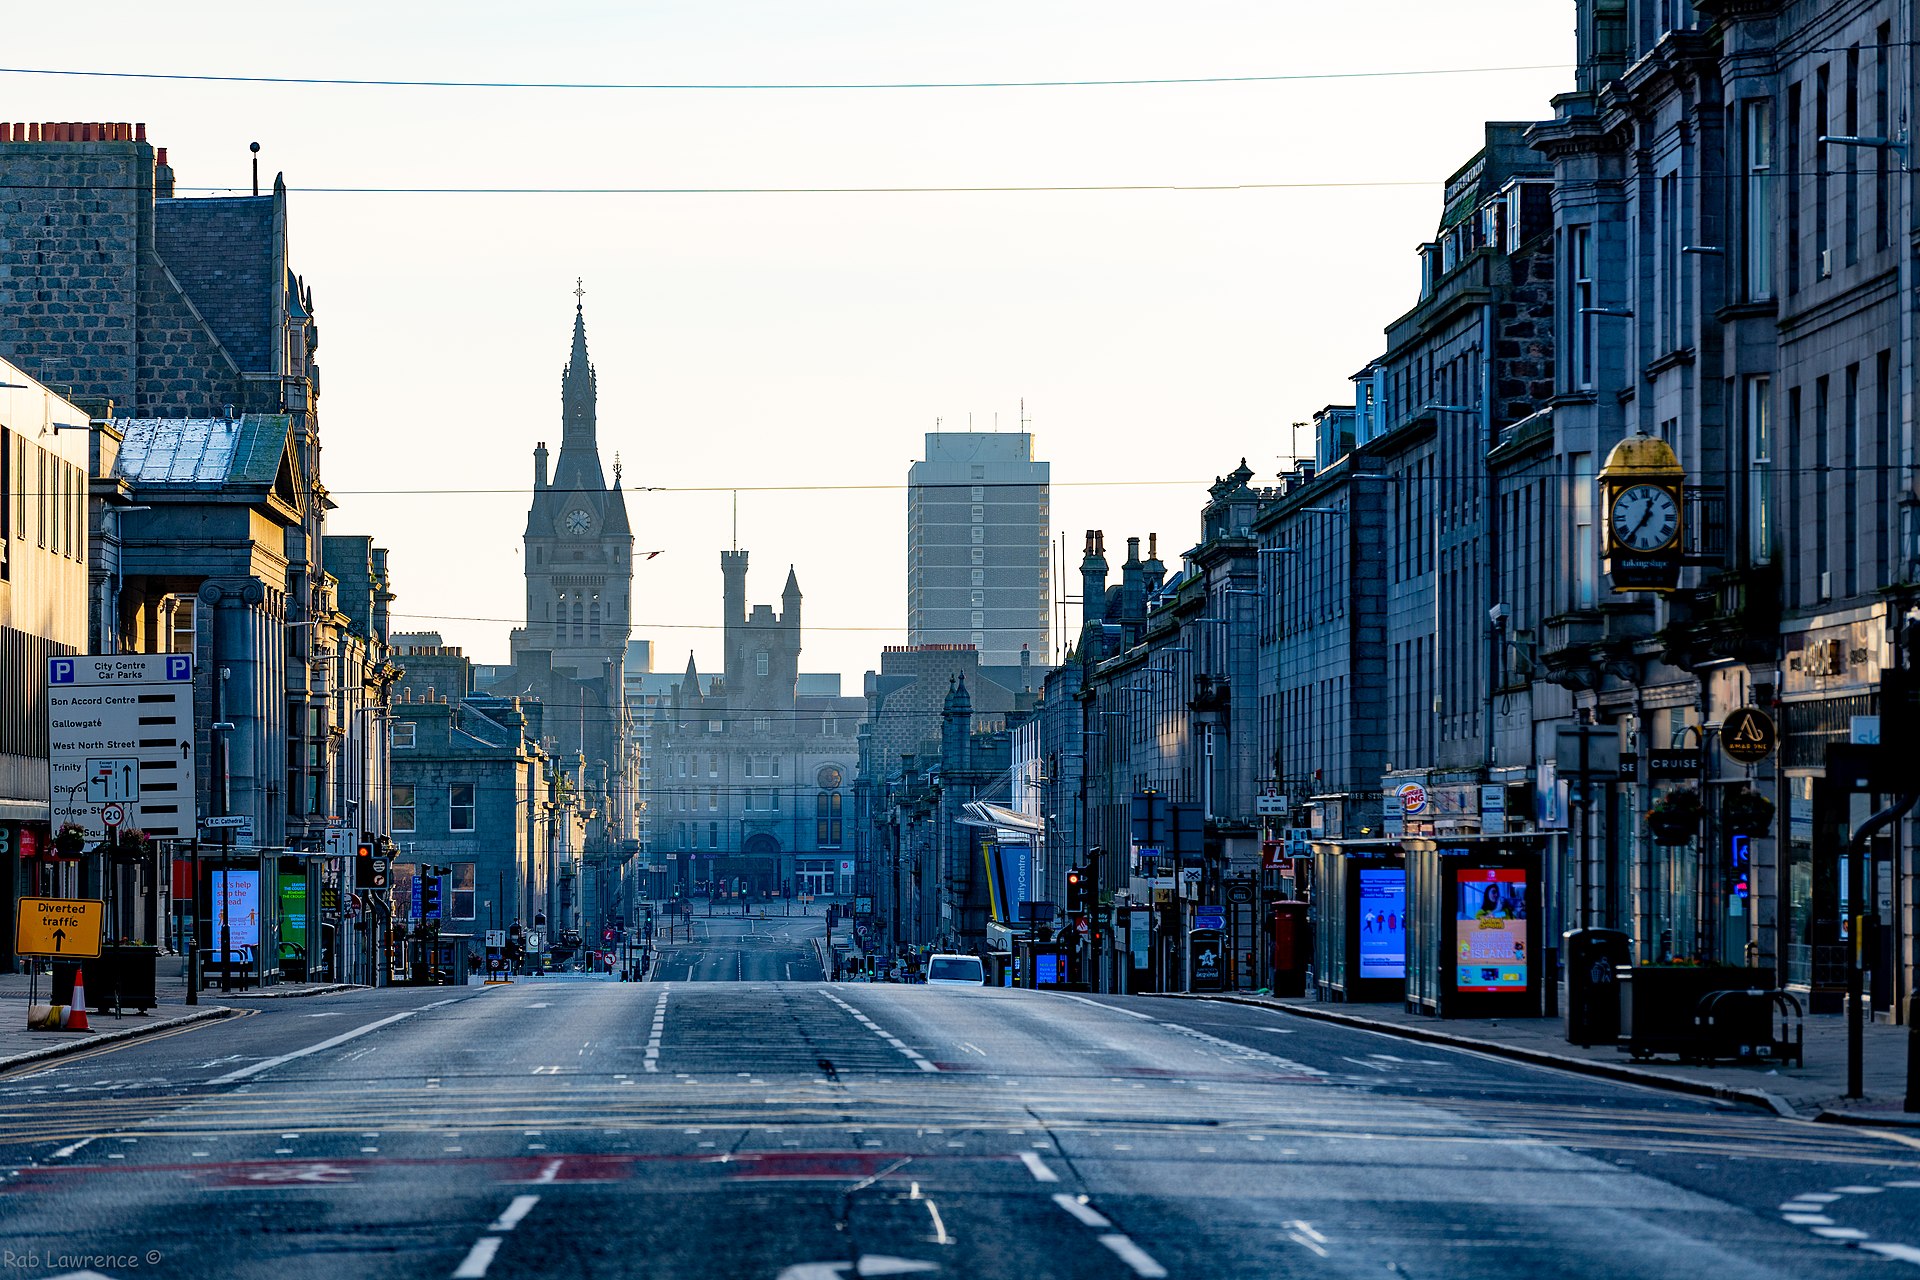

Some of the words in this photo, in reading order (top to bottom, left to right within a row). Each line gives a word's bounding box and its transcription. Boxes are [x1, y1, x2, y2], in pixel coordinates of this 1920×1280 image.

[94, 662, 116, 671] City
[117, 671, 142, 679] Parks
[71, 697, 102, 705] Accord
[53, 742, 75, 750] West
[78, 741, 104, 749] North
[107, 740, 135, 748] Street
[53, 763, 81, 772] Trinity
[1621, 763, 1635, 772] SE
[1651, 759, 1697, 768] CRUISE
[1350, 792, 1365, 800] DEE
[1367, 792, 1383, 800] STR
[54, 807, 87, 816] College
[105, 811, 120, 820] 20
[1018, 854, 1026, 901] inityCentre
[235, 881, 252, 889] help
[38, 903, 86, 914] Diverted
[42, 917, 78, 927] traffic
[1471, 949, 1513, 959] ISLAND
